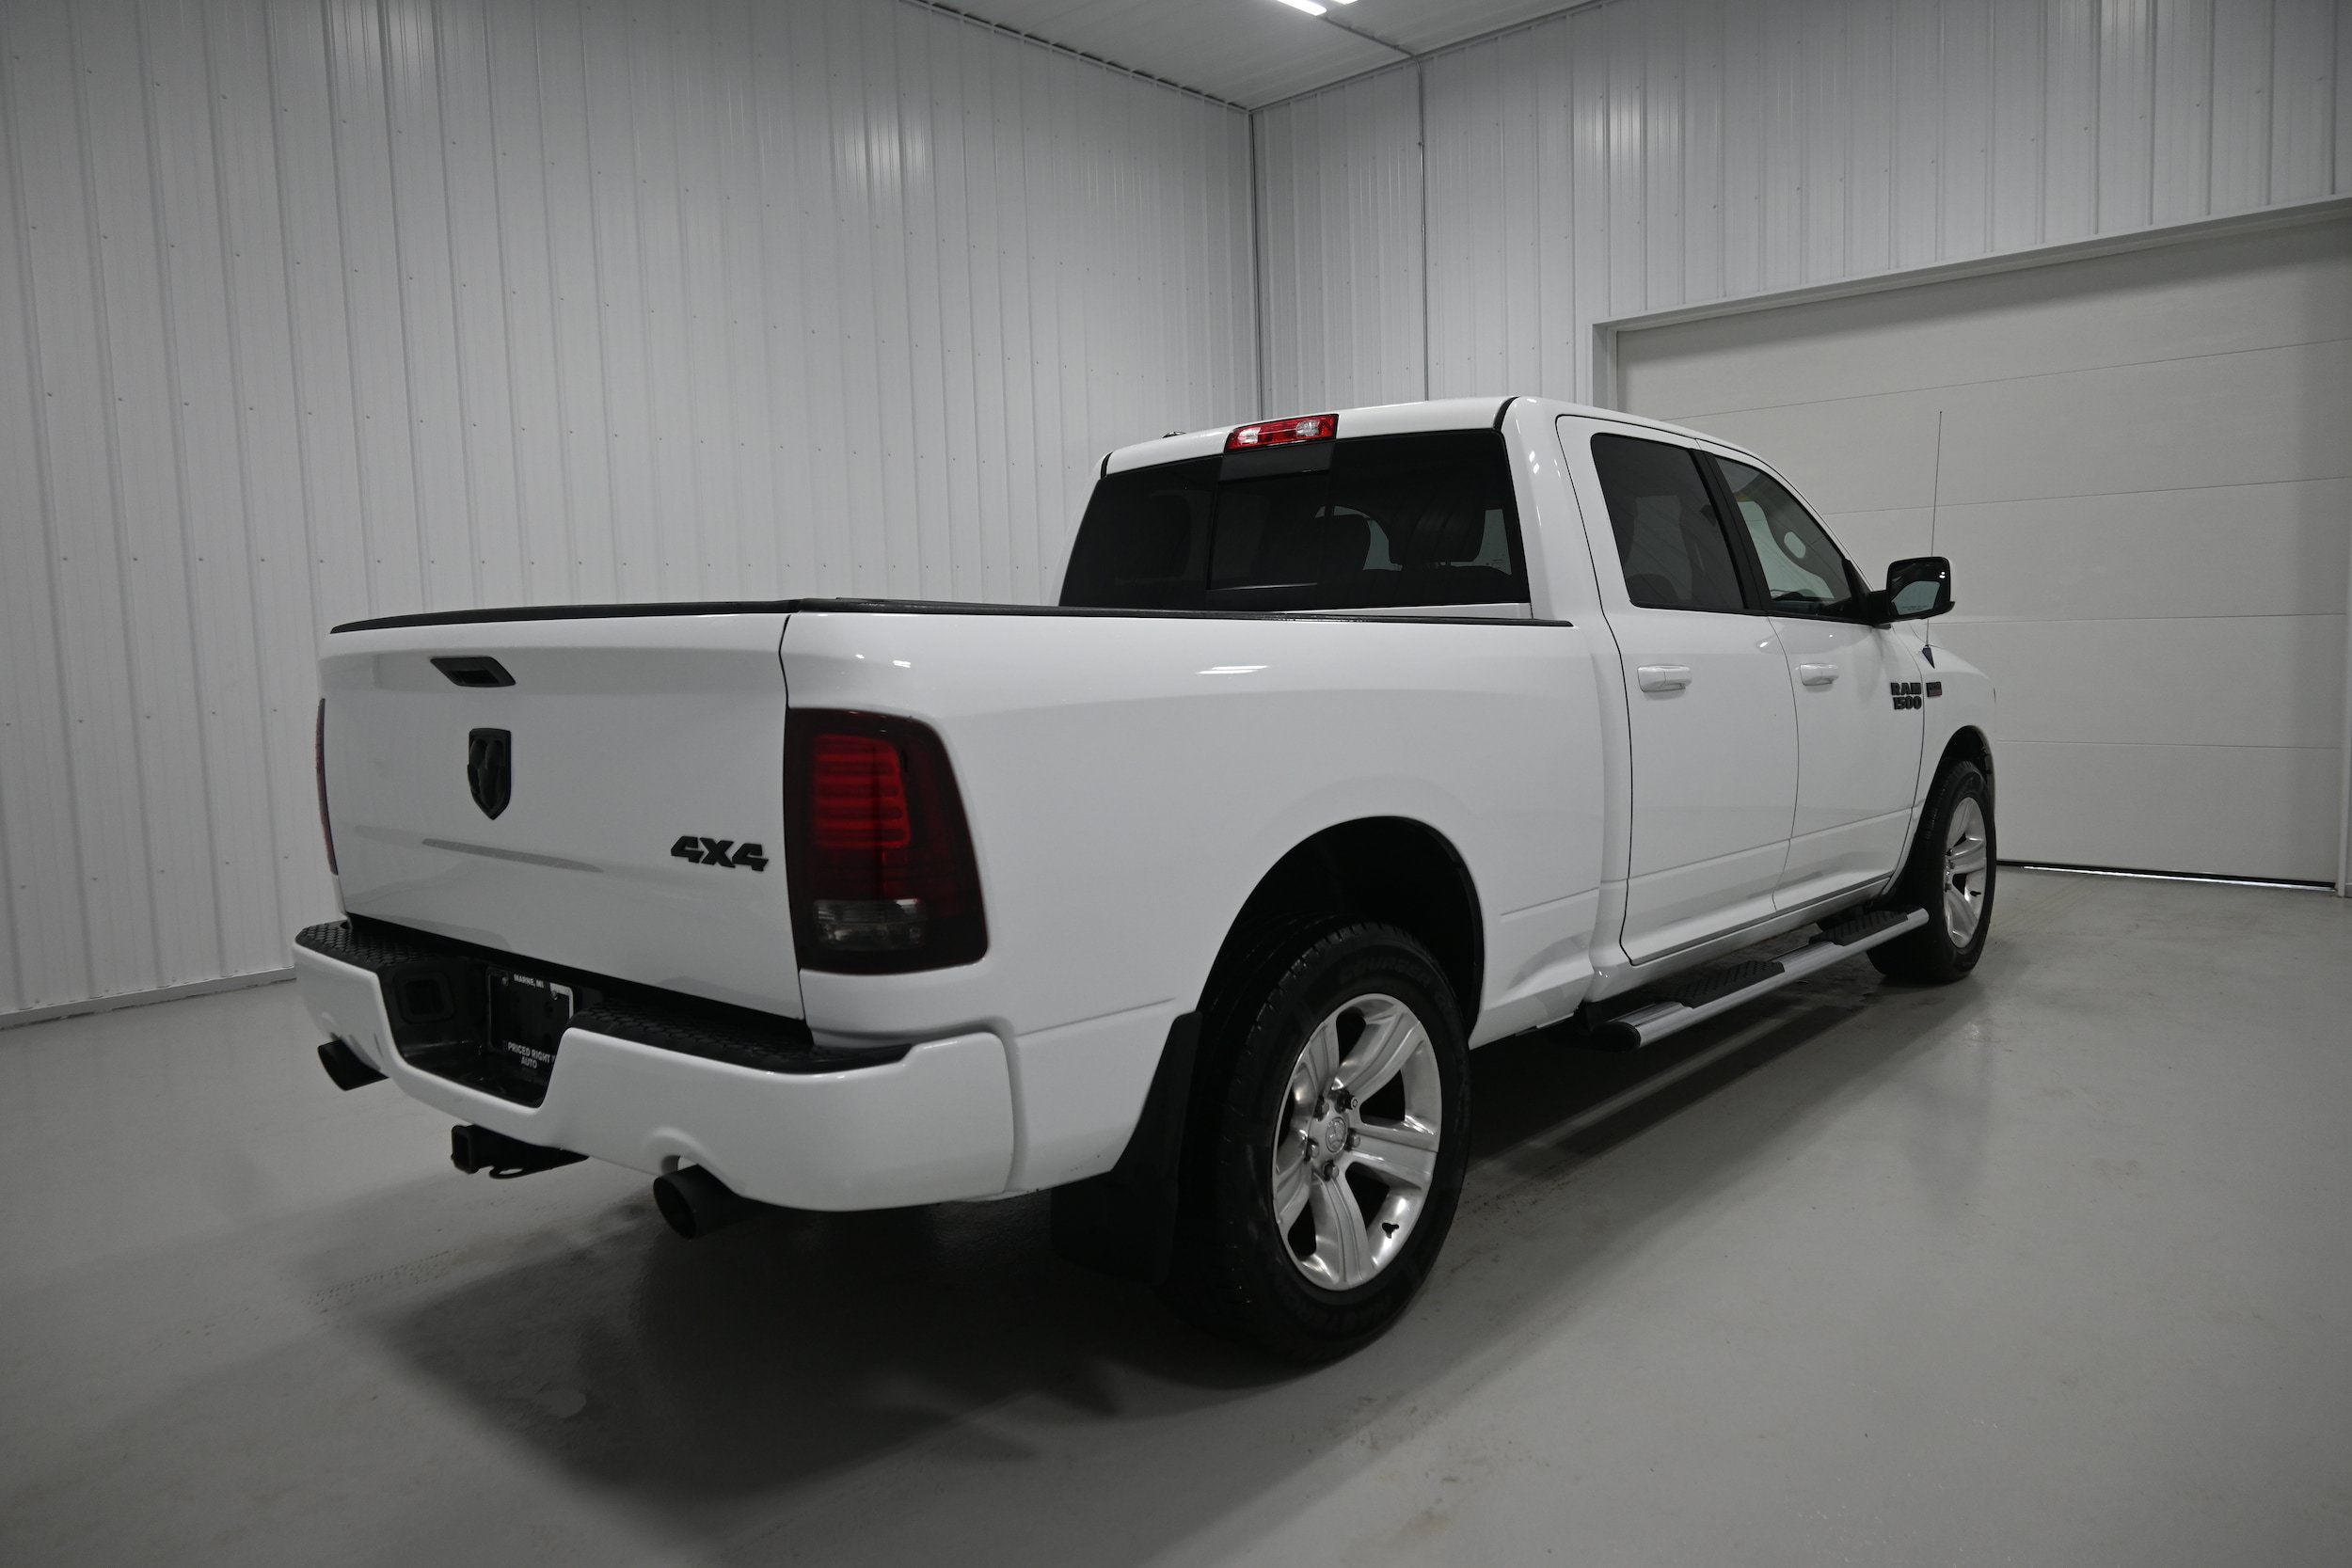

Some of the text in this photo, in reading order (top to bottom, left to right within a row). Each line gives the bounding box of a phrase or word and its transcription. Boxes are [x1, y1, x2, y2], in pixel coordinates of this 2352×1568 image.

[1890, 682, 1922, 696] RAM
[1893, 695, 1922, 710] 1500
[670, 835, 770, 872] 4X4
[508, 1041, 551, 1064] PRICED RIGHT
[520, 1056, 538, 1069] AUTO
